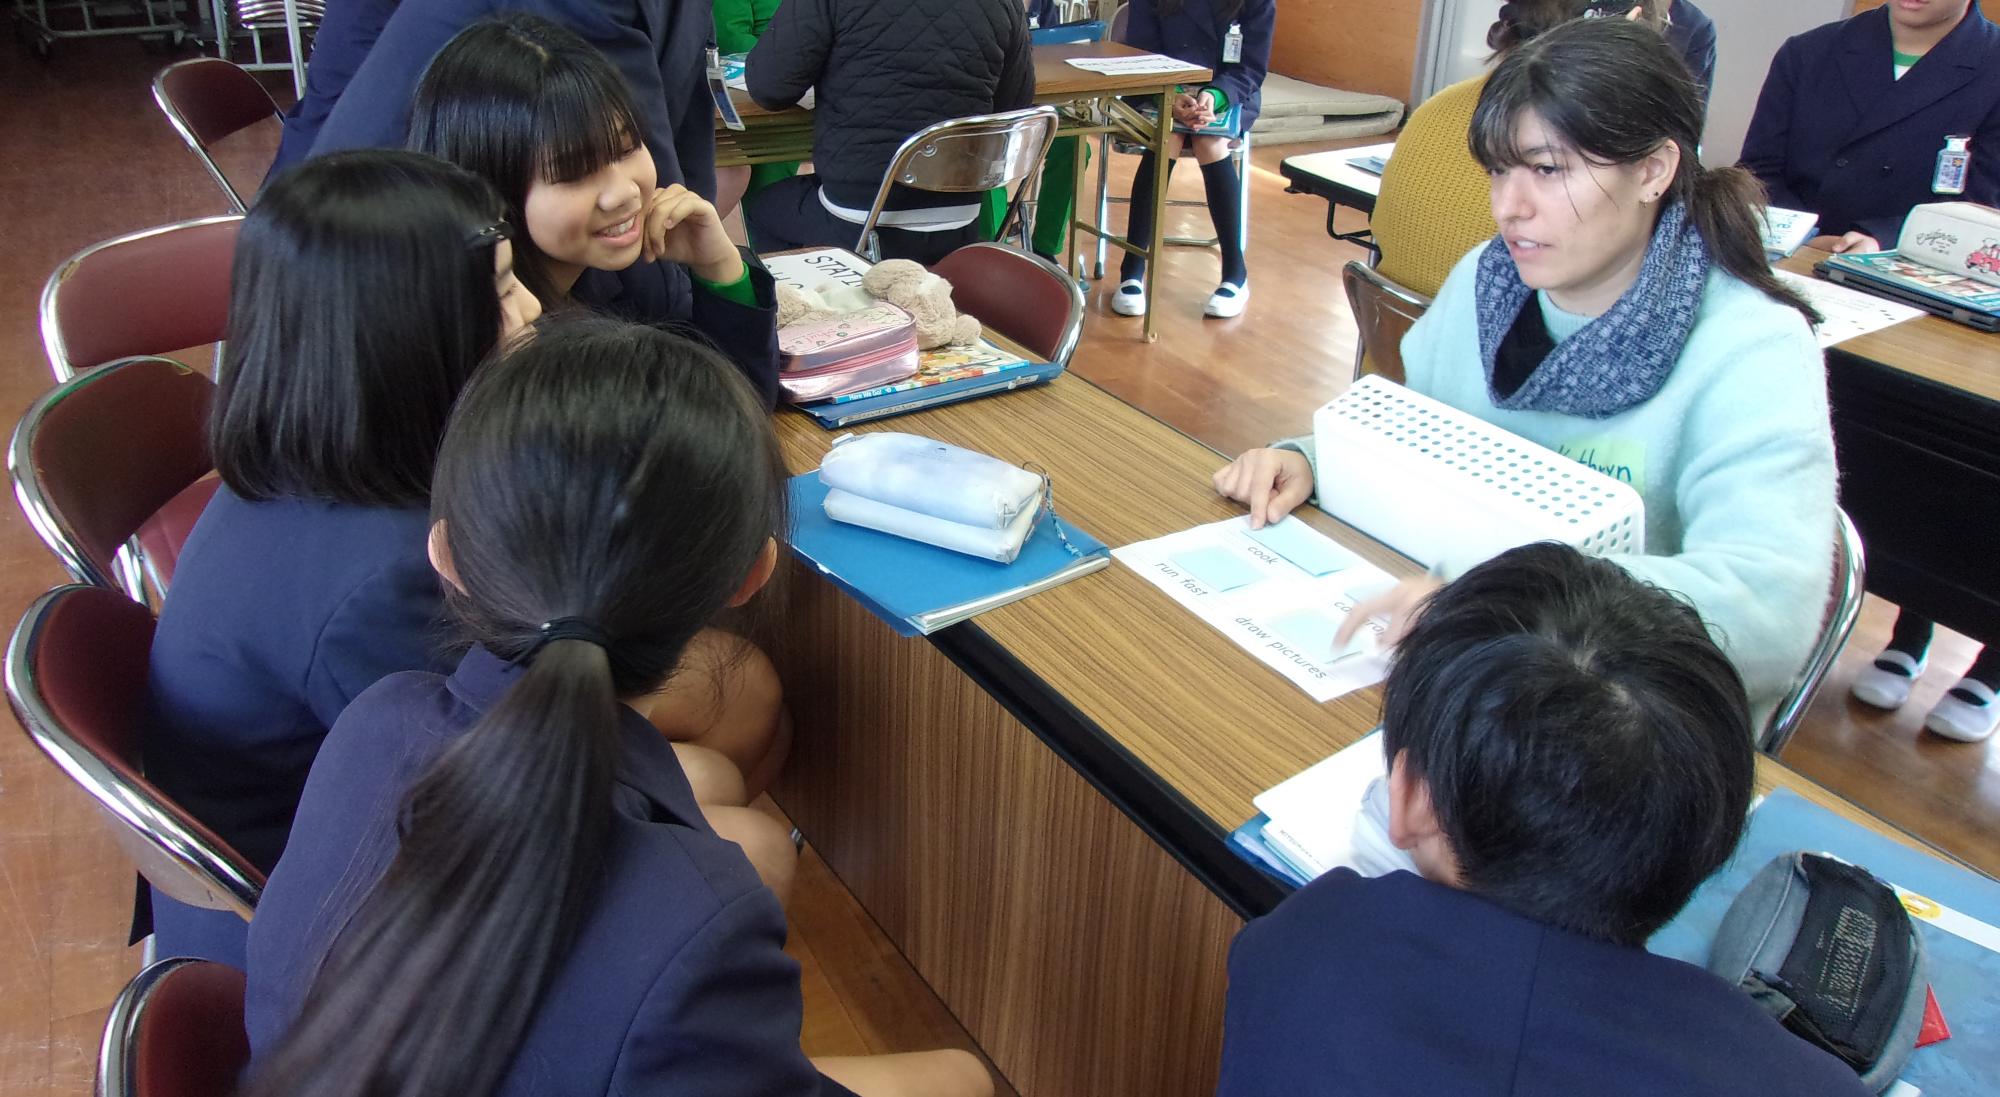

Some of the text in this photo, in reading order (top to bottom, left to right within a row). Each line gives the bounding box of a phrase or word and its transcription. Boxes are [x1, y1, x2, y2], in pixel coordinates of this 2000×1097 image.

[804, 255, 863, 287] STATI
[1247, 545, 1279, 566] cook
[1153, 562, 1209, 596] run fast
[1235, 616, 1328, 680] draw pictures
